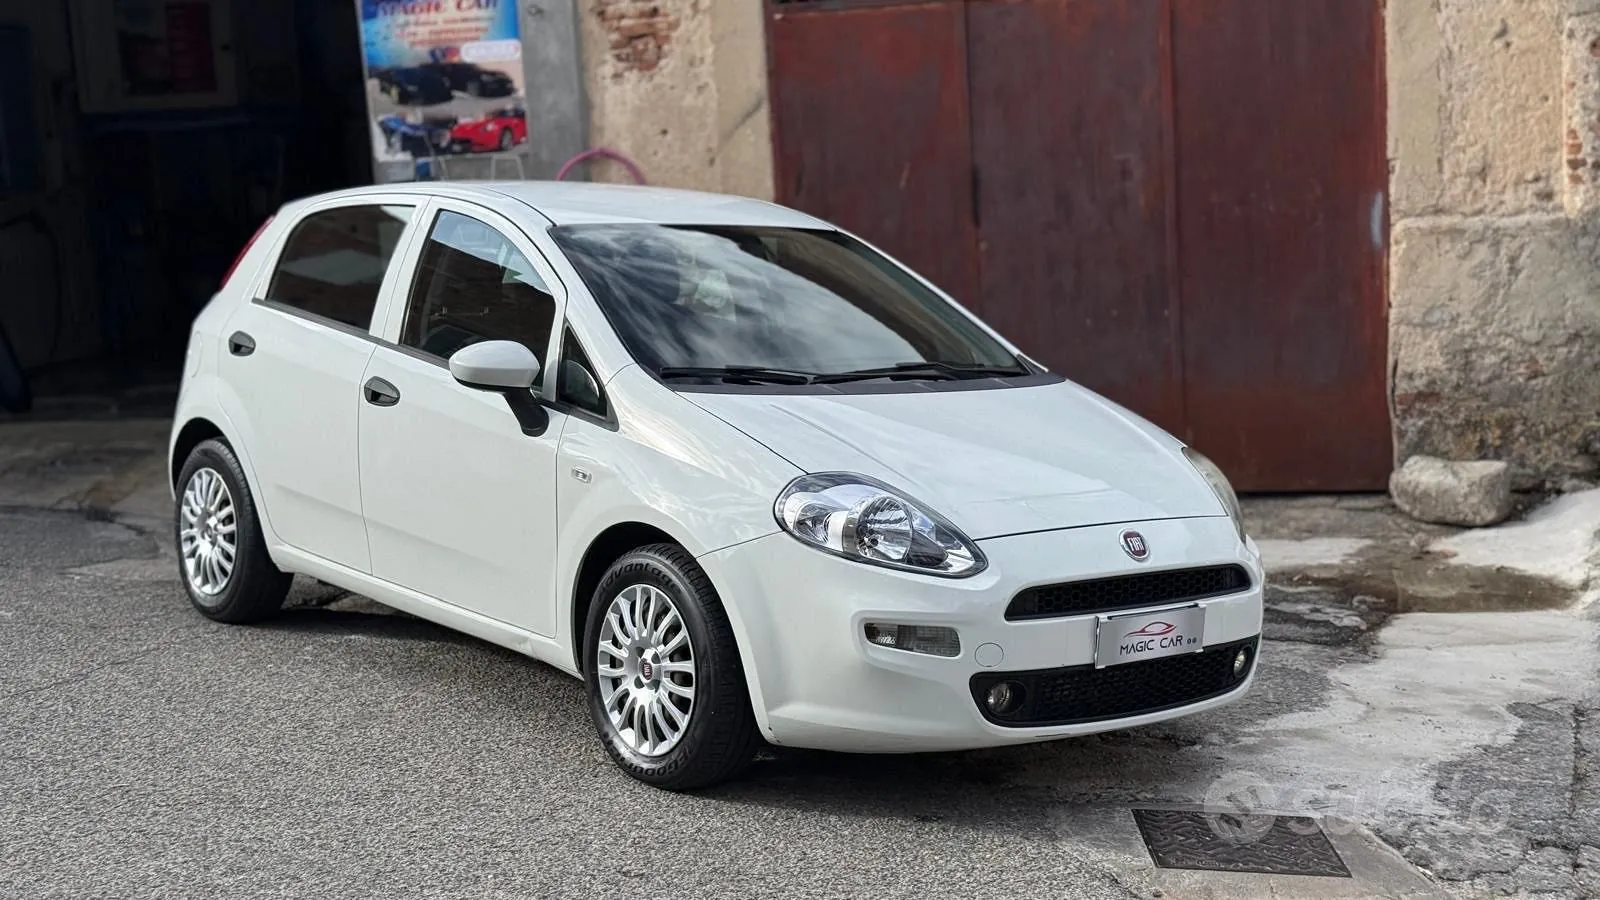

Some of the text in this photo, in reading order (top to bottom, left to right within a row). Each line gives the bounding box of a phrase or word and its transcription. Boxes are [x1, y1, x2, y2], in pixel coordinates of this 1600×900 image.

[1126, 536, 1145, 551] FIAT
[1120, 635, 1184, 656] MAGIC CAR
